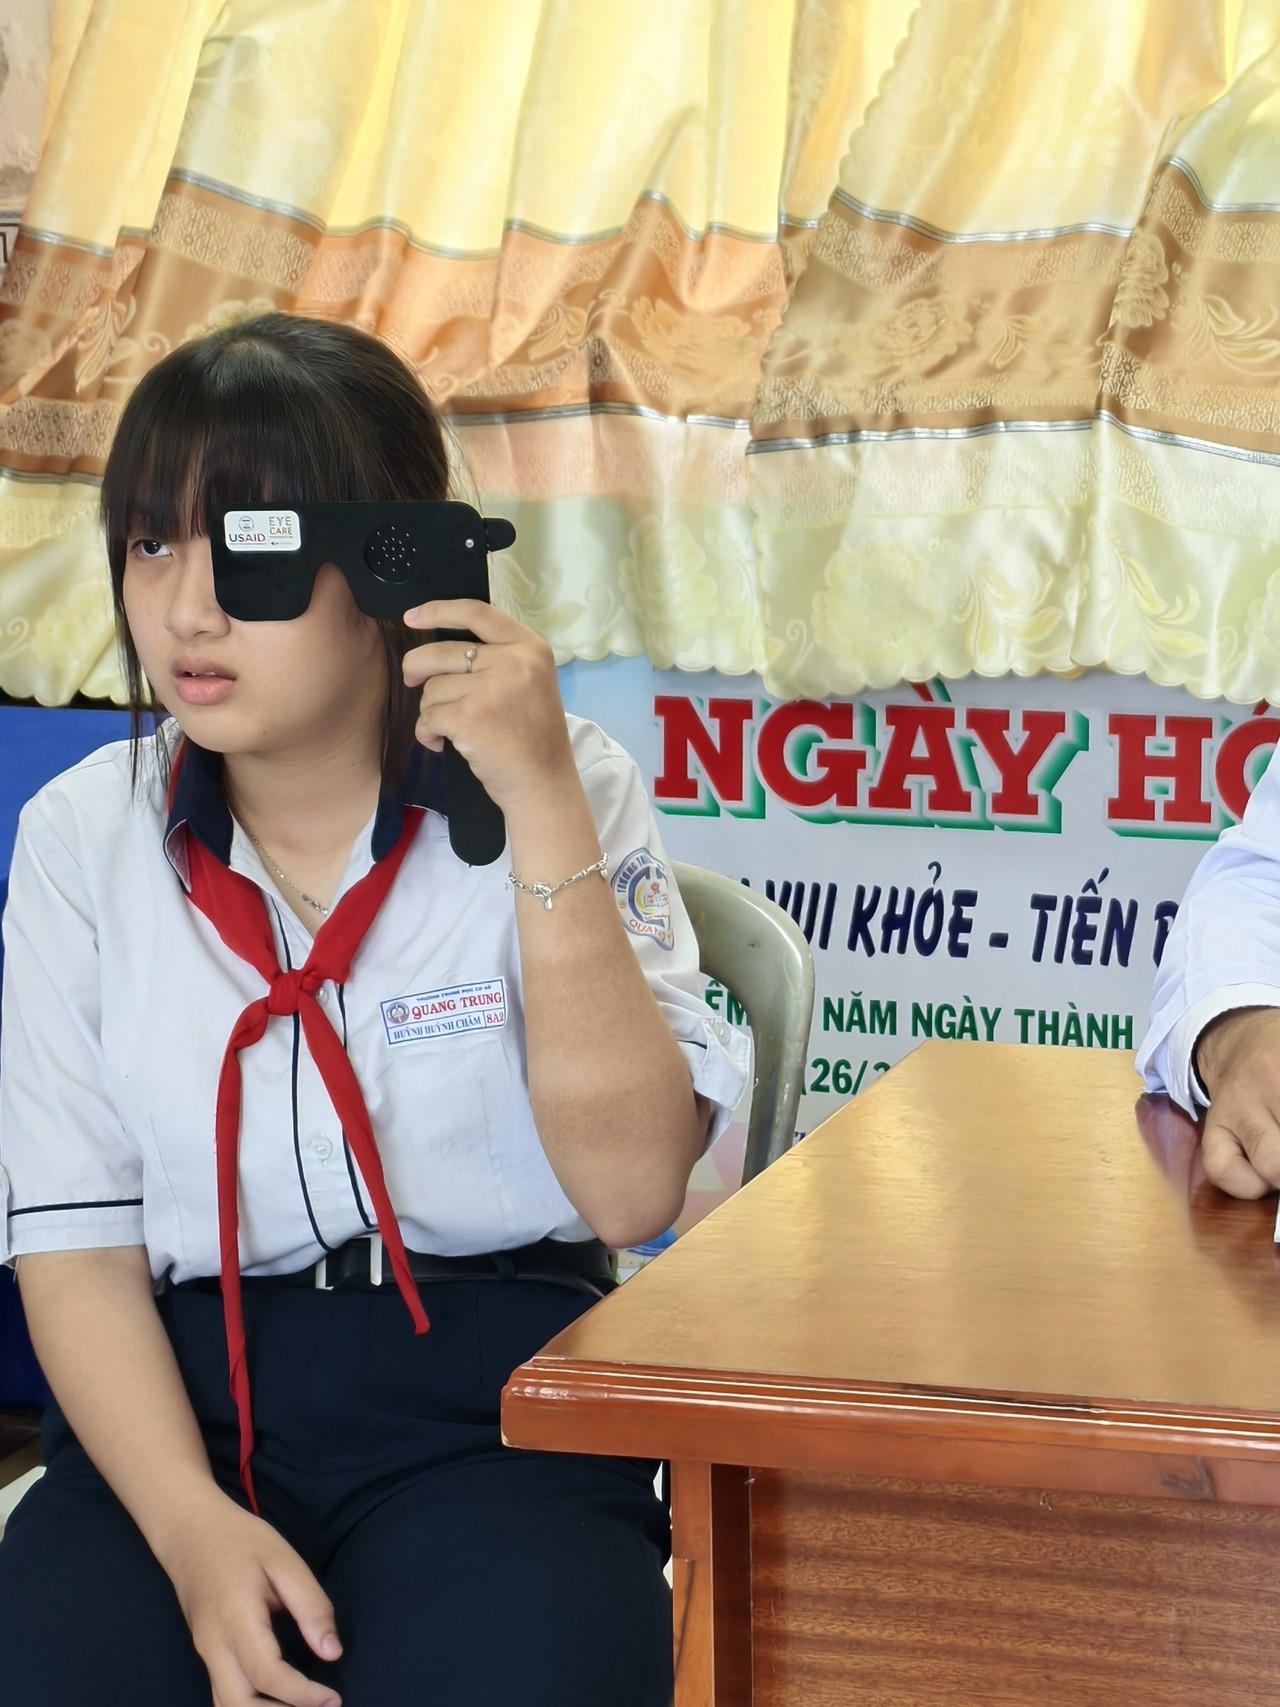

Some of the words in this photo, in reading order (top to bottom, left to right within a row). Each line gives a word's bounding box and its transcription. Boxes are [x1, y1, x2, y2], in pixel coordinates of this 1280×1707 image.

[269, 516, 292, 526] EYE
[269, 527, 293, 535] CARE
[228, 533, 266, 543] USAID
[654, 679, 1067, 817] NGÀY
[847, 860, 978, 959] KHỎE
[1030, 867, 1138, 968] TIẾN
[411, 999, 456, 1020] QUANG
[460, 992, 502, 1008] TRUNG
[823, 990, 898, 1036] NĂM
[911, 994, 1002, 1042] NGÀY
[1014, 1002, 1133, 1050] THÀNH
[801, 1057, 891, 1096] 26/
